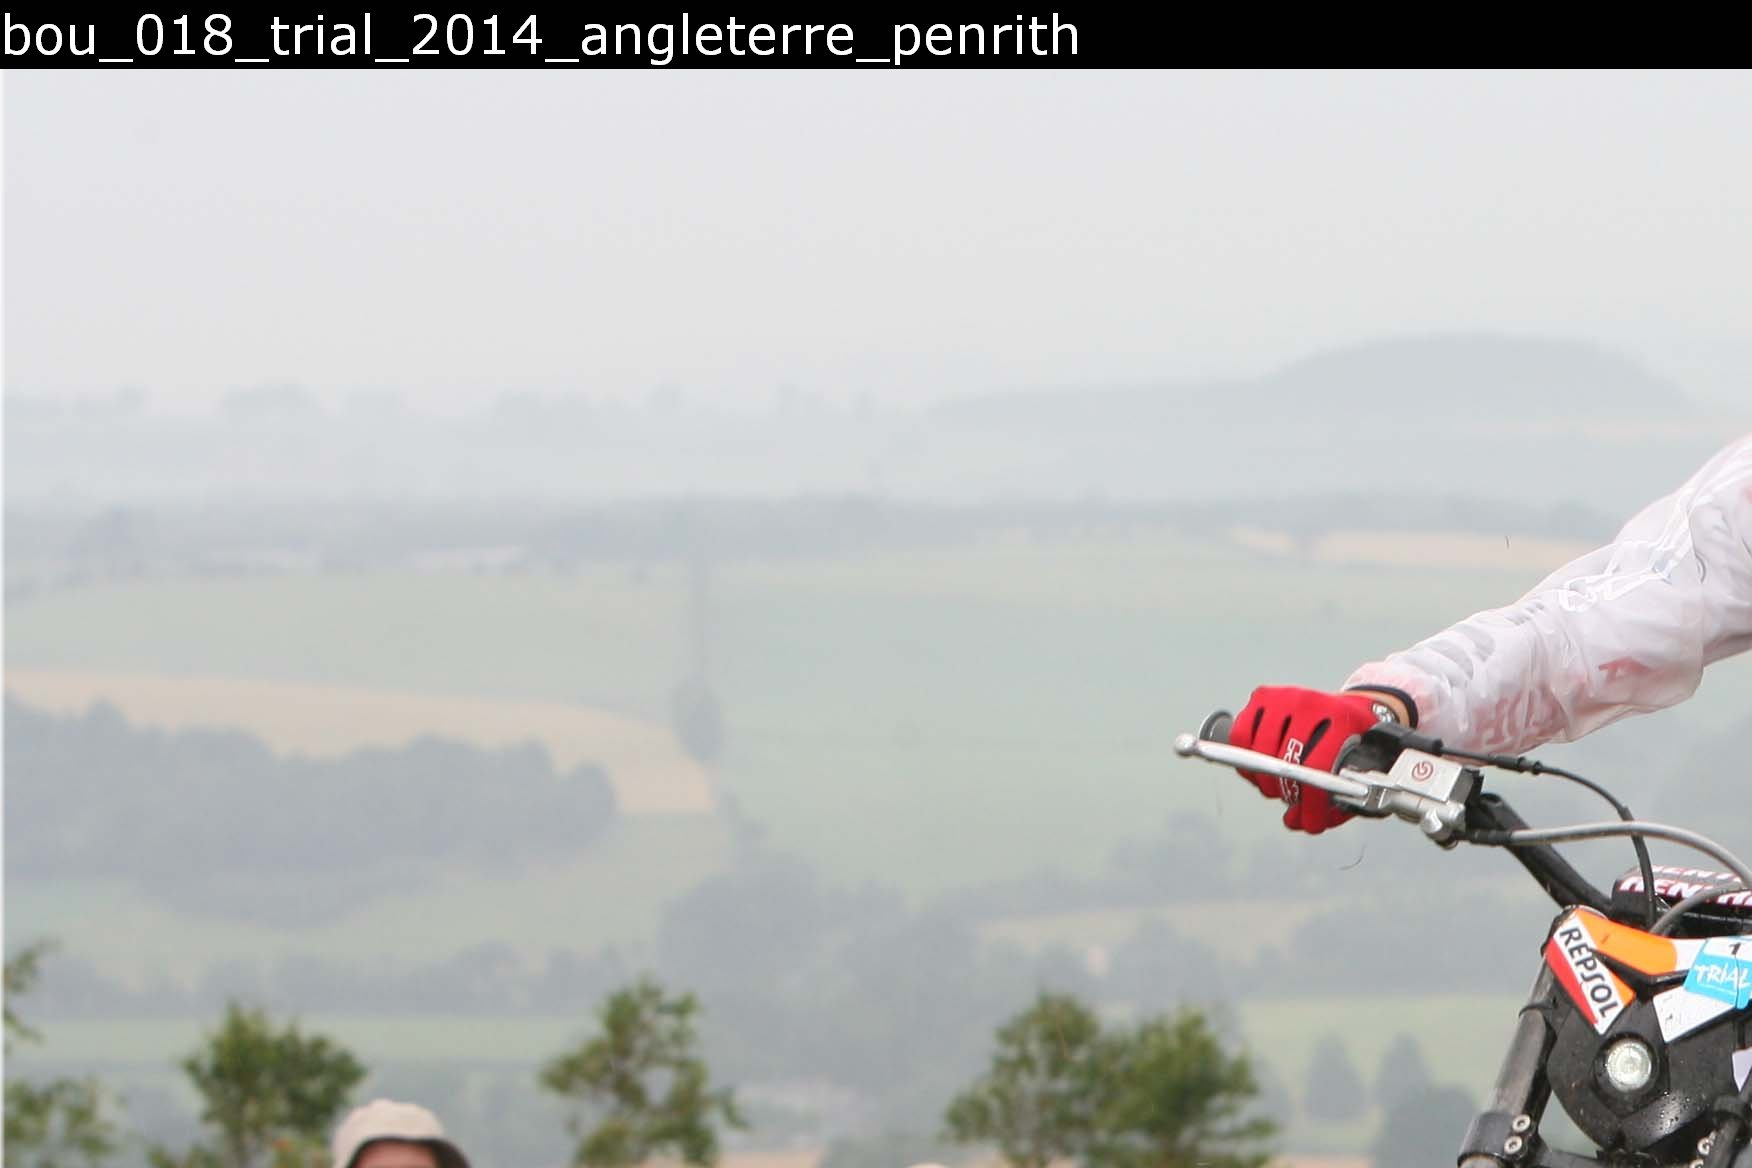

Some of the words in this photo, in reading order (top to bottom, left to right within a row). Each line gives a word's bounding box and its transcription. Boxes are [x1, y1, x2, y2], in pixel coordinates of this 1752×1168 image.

[1728, 942, 1740, 955] 1
[1560, 925, 1620, 1020] REPSOL
[1692, 961, 1751, 990] TRIAL
